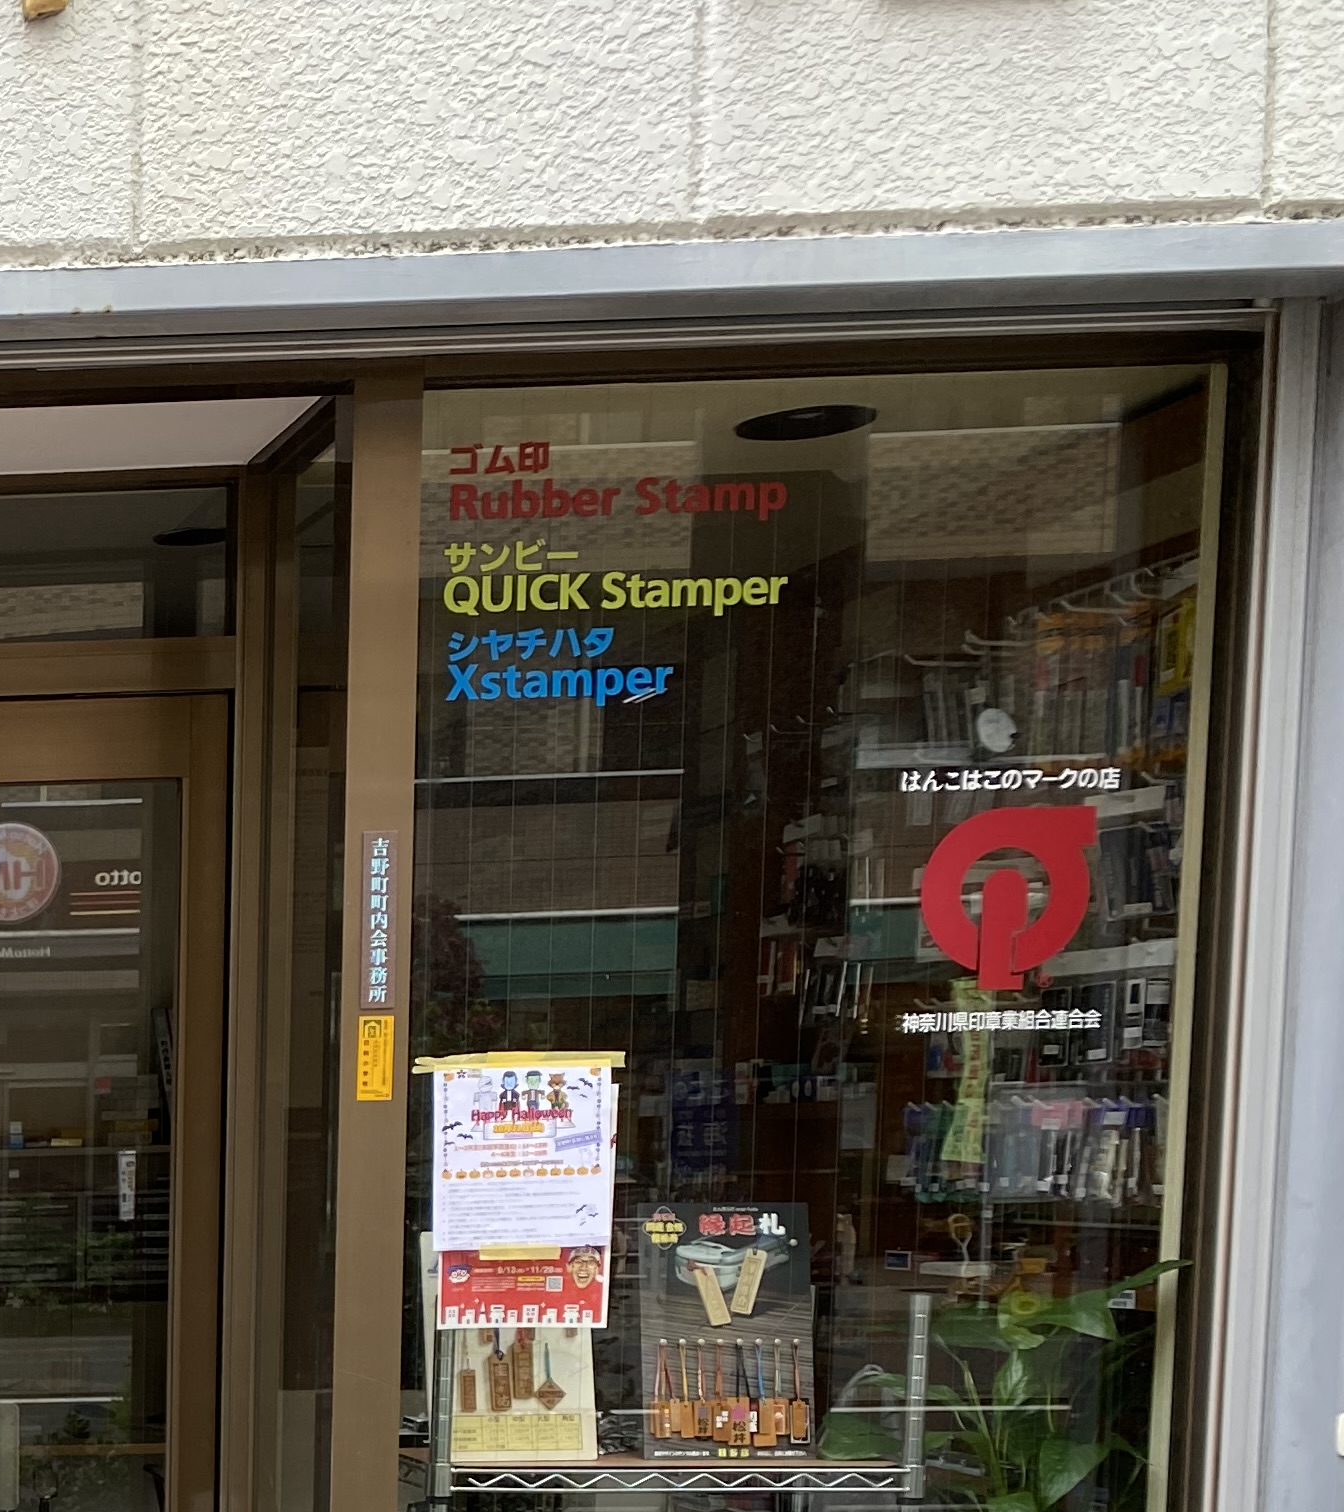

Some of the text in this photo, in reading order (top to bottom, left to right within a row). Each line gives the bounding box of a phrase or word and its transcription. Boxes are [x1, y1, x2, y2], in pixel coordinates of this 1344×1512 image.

[449, 441, 550, 475] ゴム印
[449, 477, 787, 521] Rubber Stamp
[444, 538, 579, 573] サンビー
[443, 572, 788, 616] QUICK Stamper
[446, 663, 674, 706] Xstamper
[900, 767, 1121, 792] はんこはこのマークの店
[368, 837, 390, 1004] 吉野町町内会事務所
[471, 1108, 574, 1124] Happy Halloween
